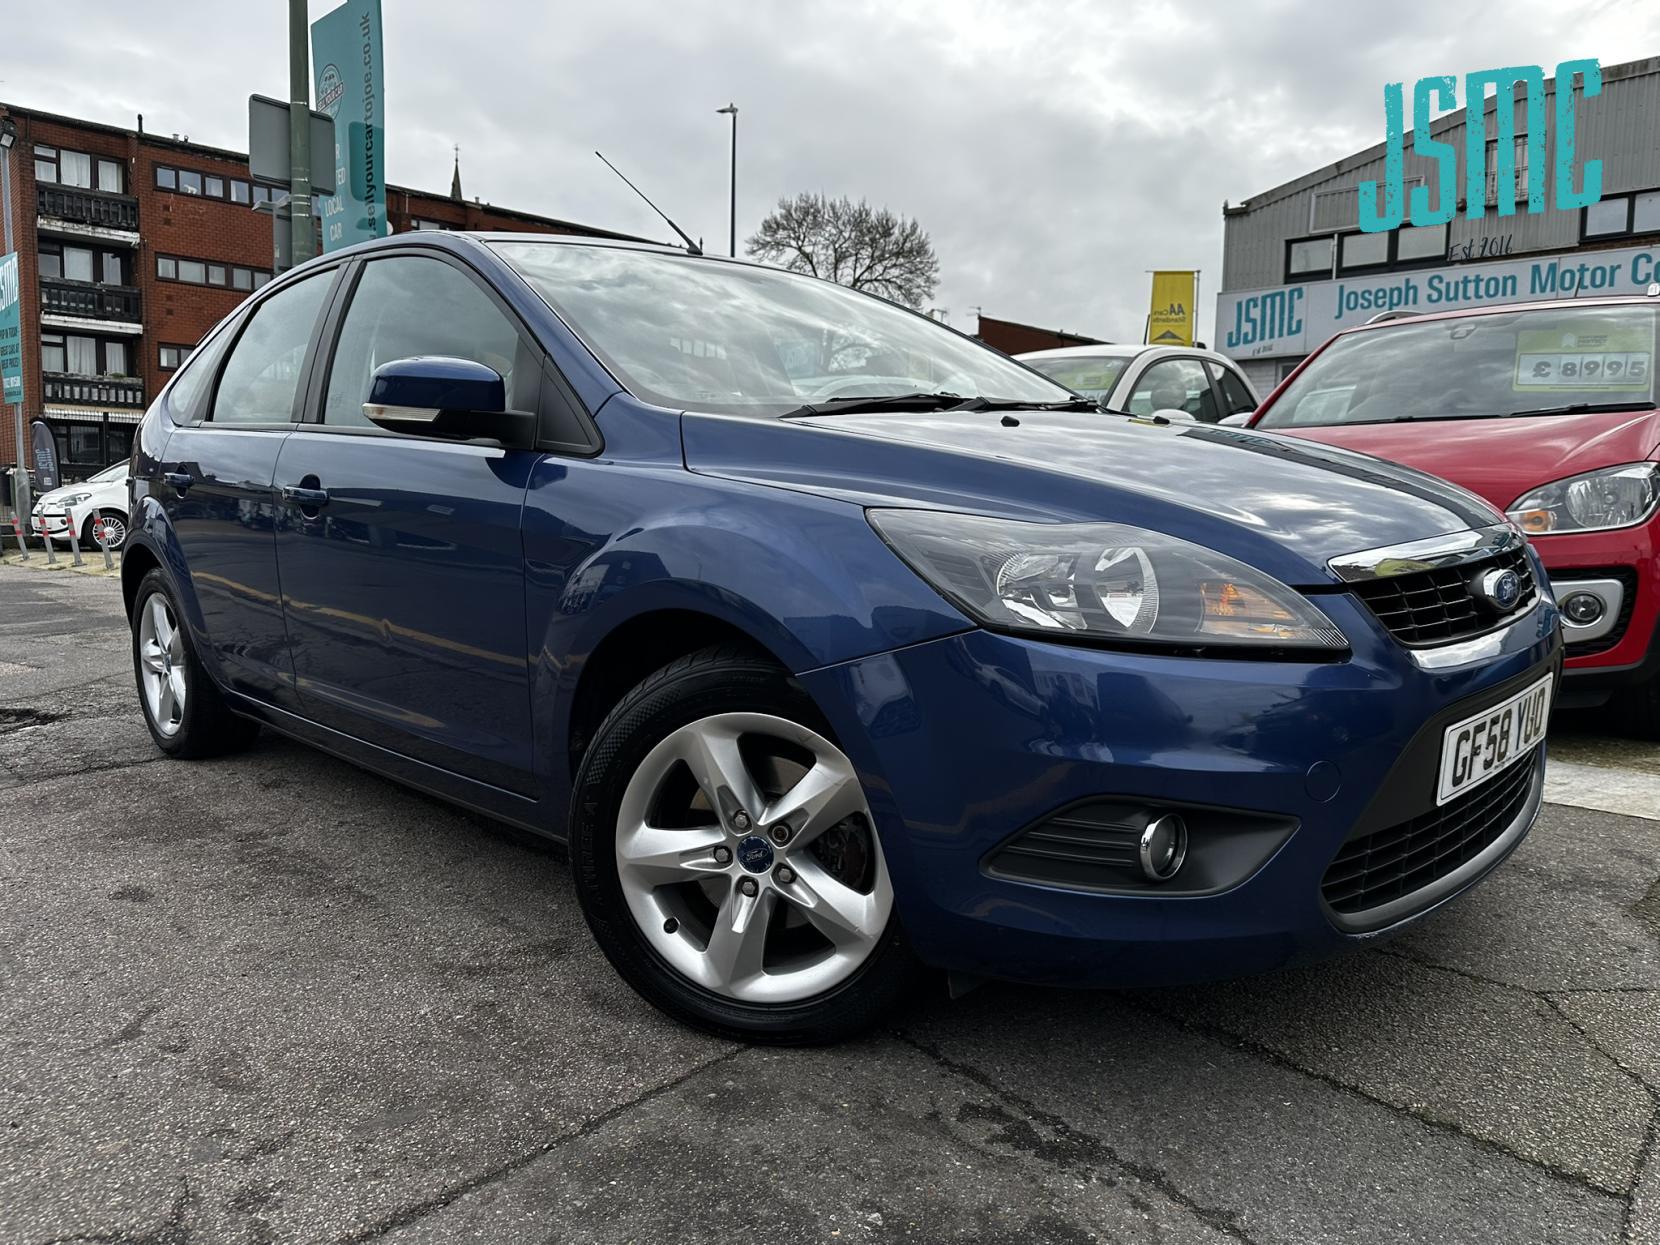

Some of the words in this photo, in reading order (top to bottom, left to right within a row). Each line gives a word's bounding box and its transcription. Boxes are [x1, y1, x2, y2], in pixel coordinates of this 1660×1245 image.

[325, 195, 344, 217] LOCAL
[330, 222, 342, 242] CAR
[0, 256, 18, 312] SMC
[1335, 278, 1418, 320] Joseph
[1427, 272, 1517, 304] Sutton
[1530, 261, 1622, 295] Motor
[1227, 287, 1303, 348] JSMC
[1452, 708, 1513, 788] GF58
